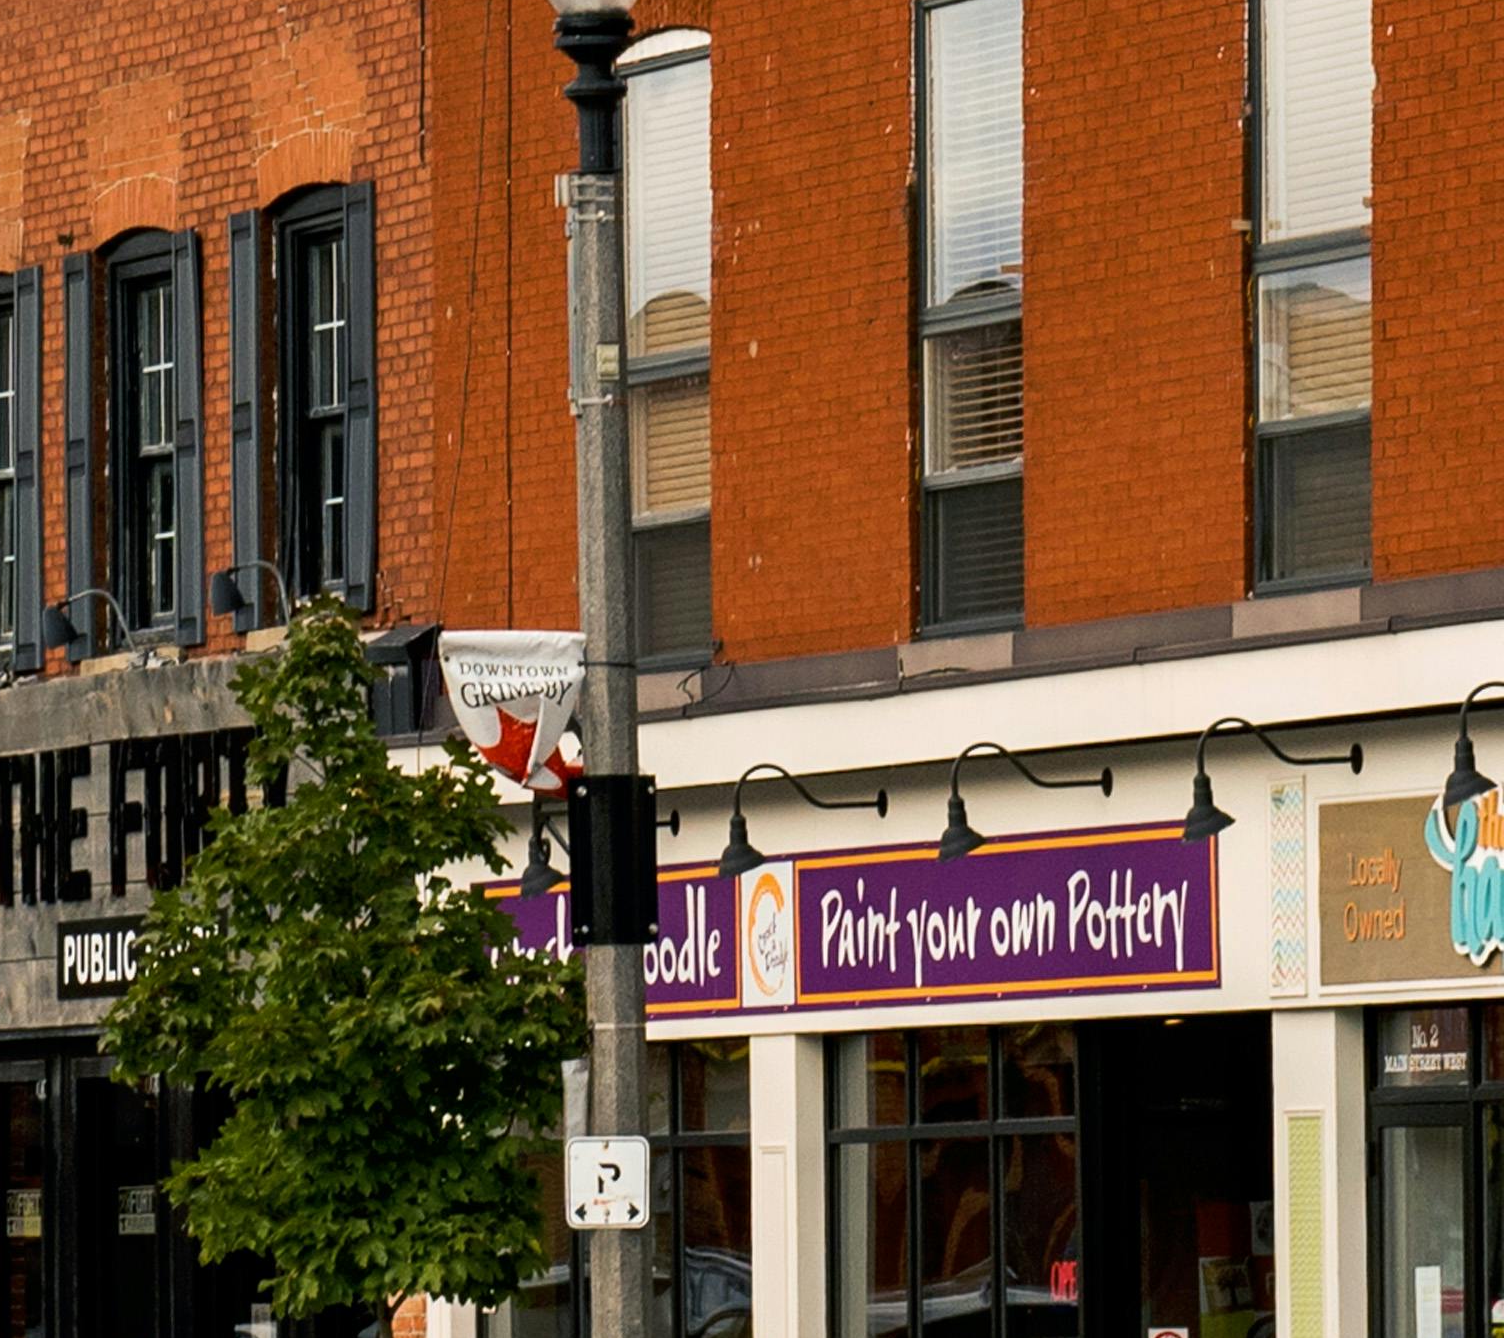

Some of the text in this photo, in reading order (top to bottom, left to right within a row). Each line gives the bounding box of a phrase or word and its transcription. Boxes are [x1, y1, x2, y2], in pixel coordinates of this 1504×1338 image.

[460, 662, 568, 678] DOWNTOWN
[461, 680, 573, 708] GRIMSBY
[1348, 847, 1403, 893] Locally
[820, 867, 1188, 988] Paint your own Pottery
[1343, 897, 1406, 942] Owned
[62, 931, 138, 986] PUBLIC
[1050, 1261, 1078, 1302] OPE
